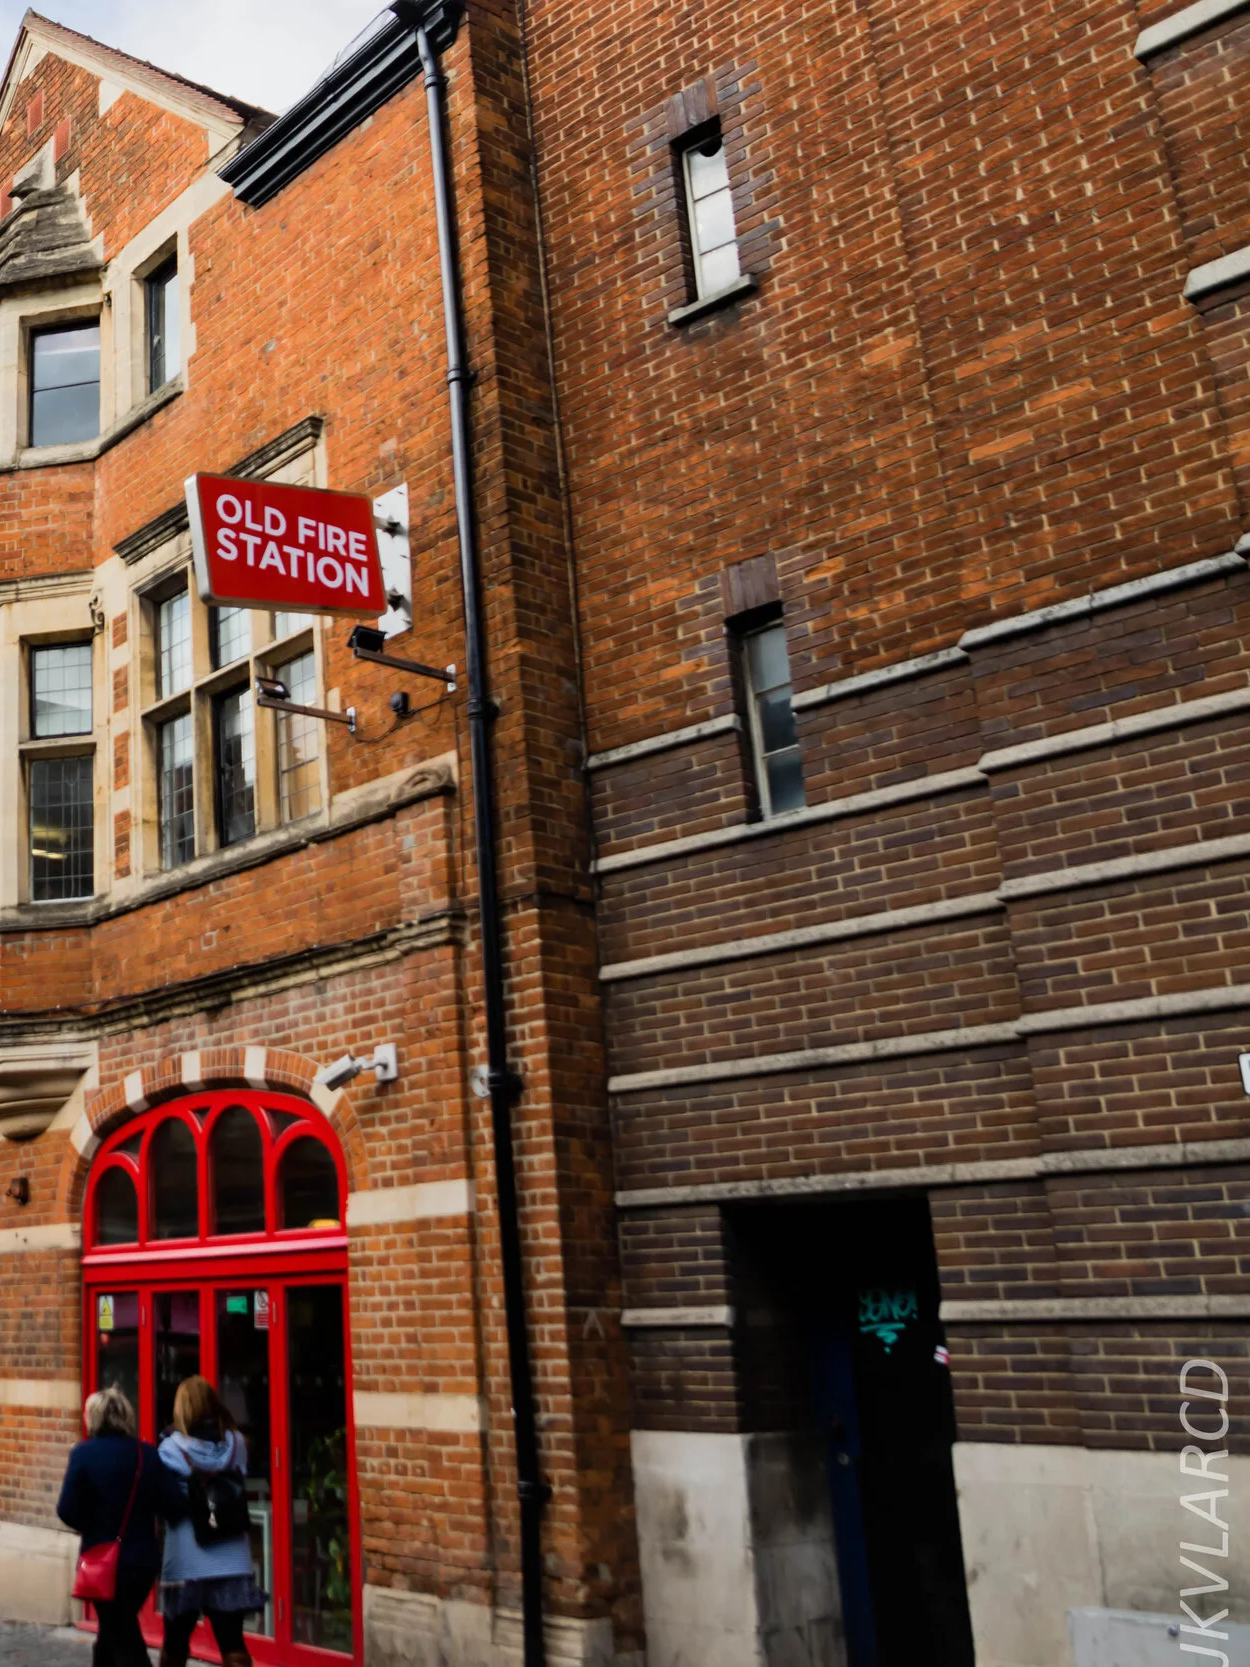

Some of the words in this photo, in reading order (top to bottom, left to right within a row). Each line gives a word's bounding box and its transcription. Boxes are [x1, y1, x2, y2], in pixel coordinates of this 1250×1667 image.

[216, 494, 287, 537] OLD
[297, 516, 368, 561] FIRE
[216, 528, 370, 597] STATION
